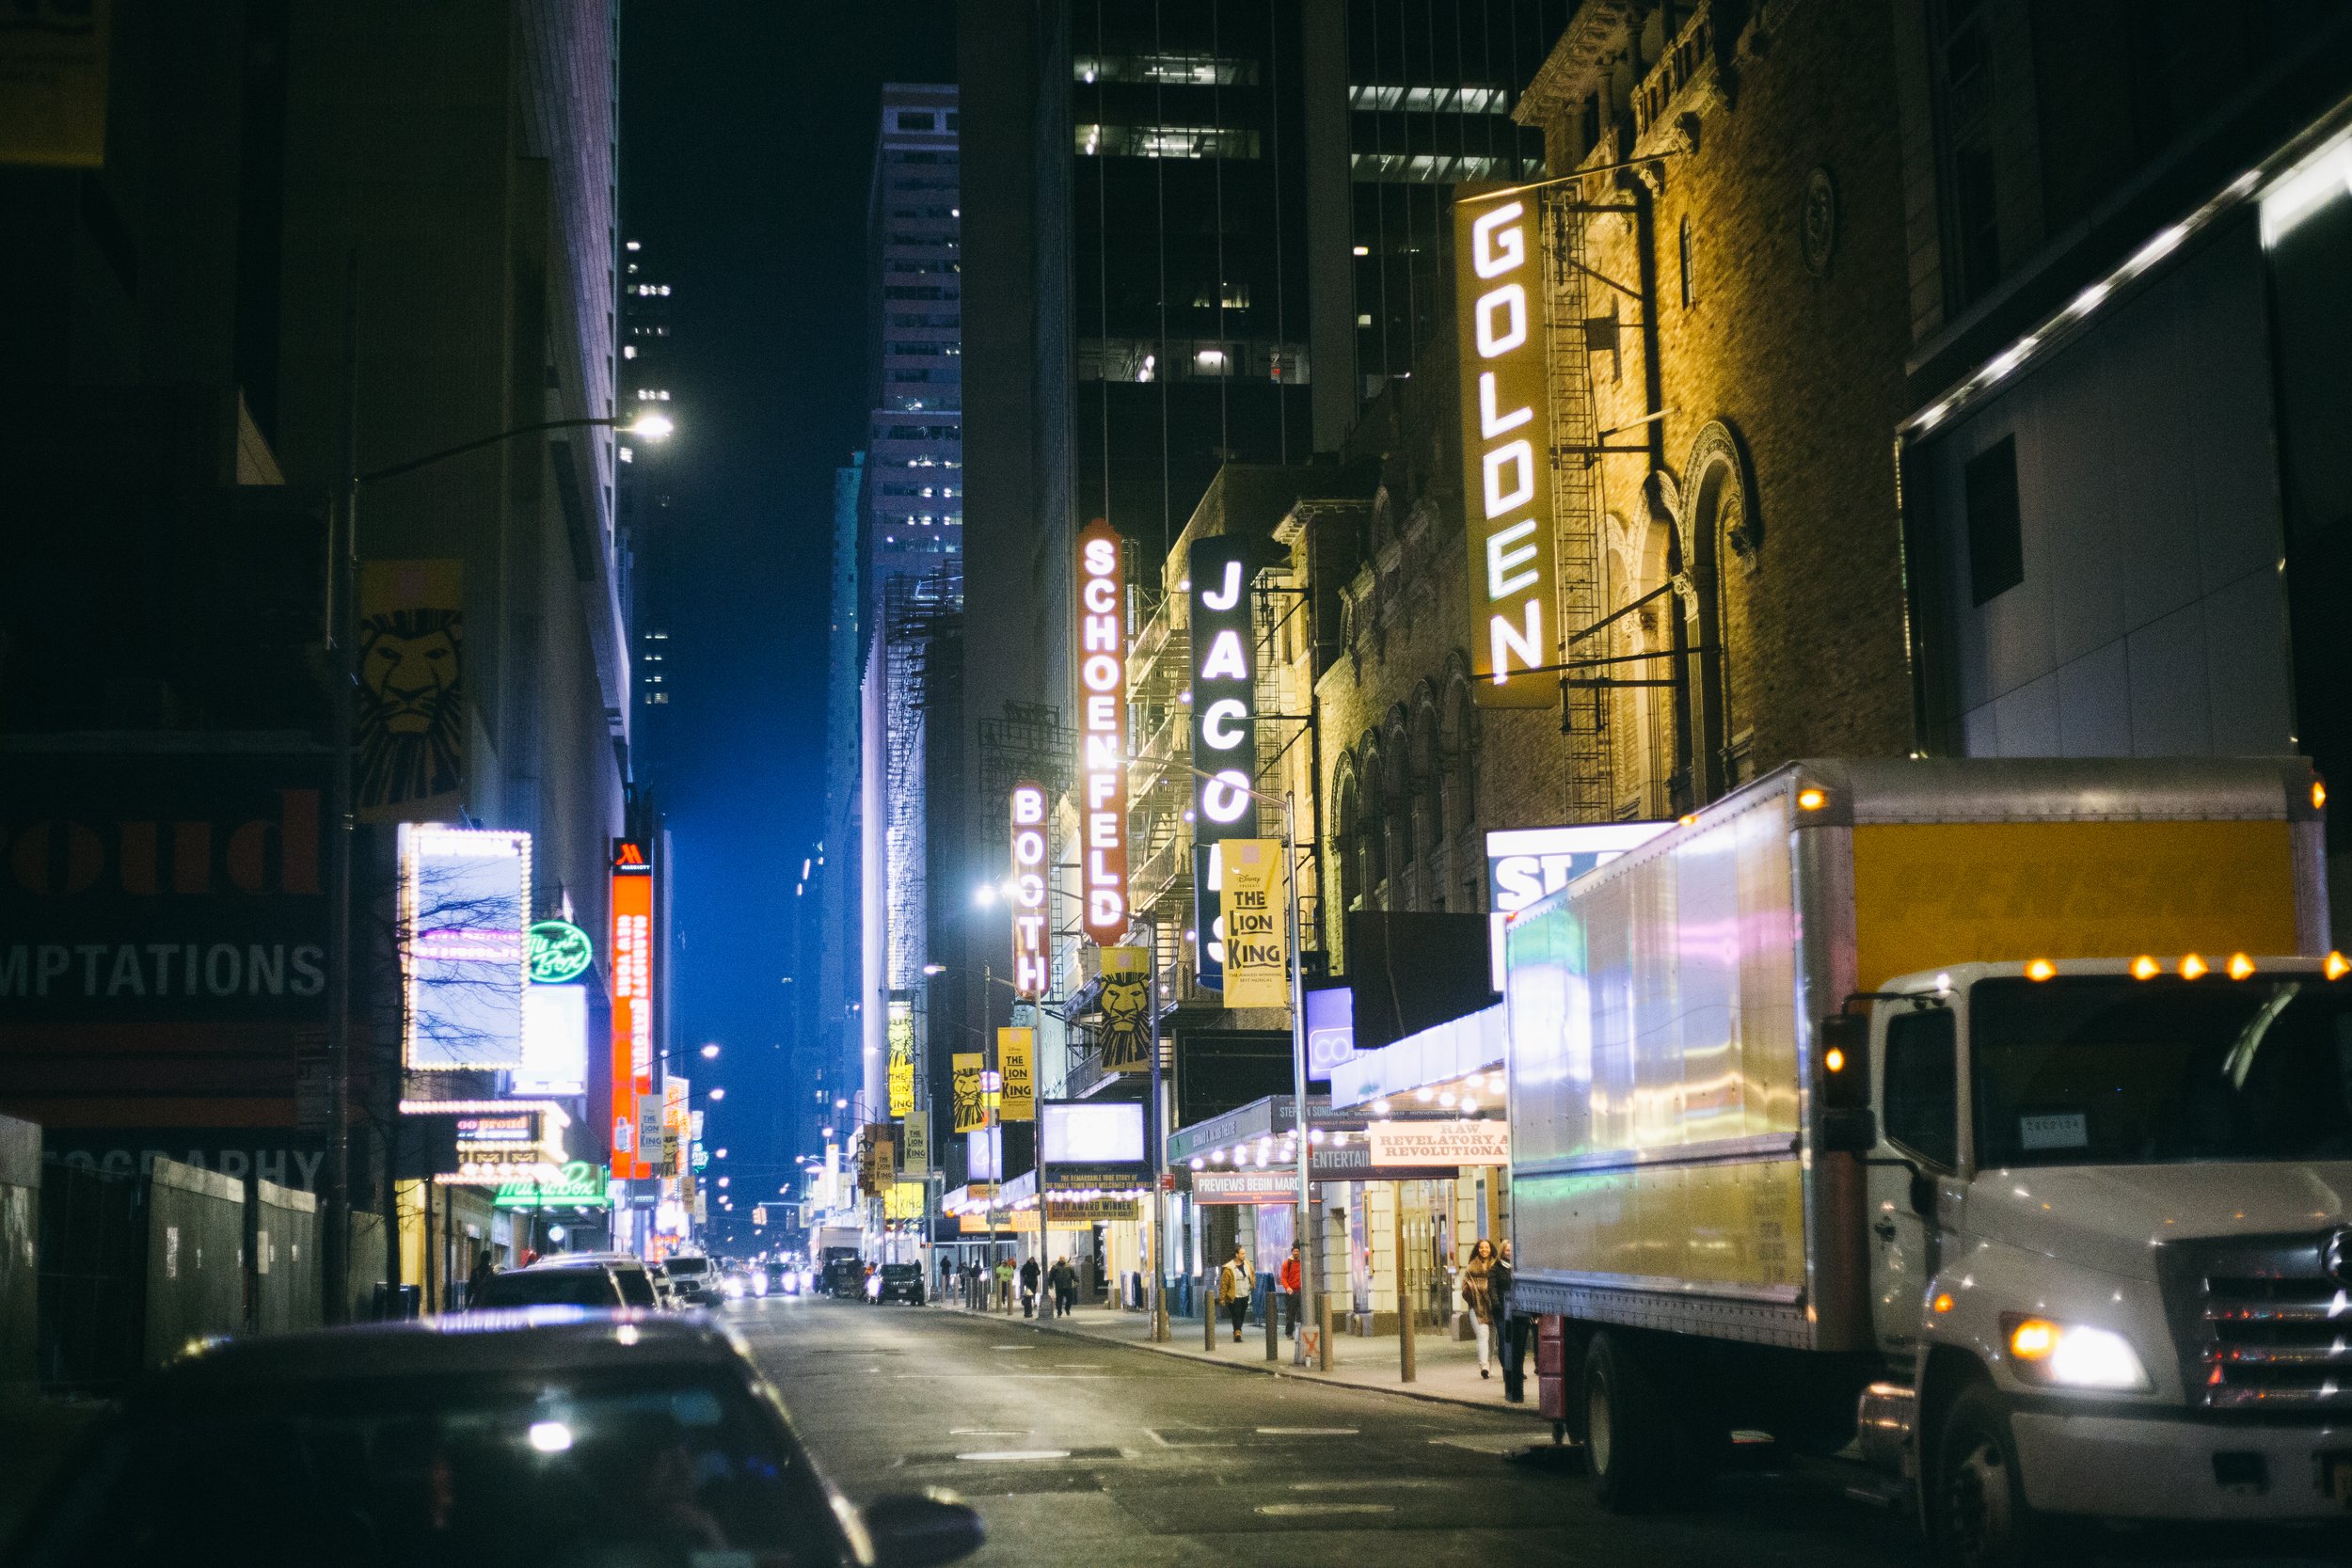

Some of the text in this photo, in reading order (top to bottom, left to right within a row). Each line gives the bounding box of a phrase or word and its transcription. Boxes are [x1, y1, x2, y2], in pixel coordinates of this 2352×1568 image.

[1472, 200, 1542, 686] GOLDEN
[1083, 539, 1123, 927] SCHOENFELD
[1201, 561, 1250, 963] JACO
[0, 788, 323, 895] oud
[1237, 873, 1262, 884] Disney
[1015, 789, 1045, 991] BOOTH
[1233, 891, 1265, 906] THE
[1230, 910, 1273, 936] LION
[1227, 938, 1280, 970] KING
[1006, 1055, 1024, 1064] THE
[1003, 1066, 1027, 1081] LION
[1002, 1082, 1032, 1099] KING
[641, 1124, 659, 1133] LION
[641, 1135, 661, 1148] KING
[907, 1139, 923, 1148] LION
[906, 1148, 926, 1159] KING
[1385, 1146, 1508, 1157] REVOLUTIONA
[1199, 1178, 1245, 1193] PREVIEWS
[1247, 1178, 1273, 1192] BEGIN
[1275, 1177, 1299, 1191] MARC
[1052, 1200, 1135, 1211] TONY AWARD WINNER!
